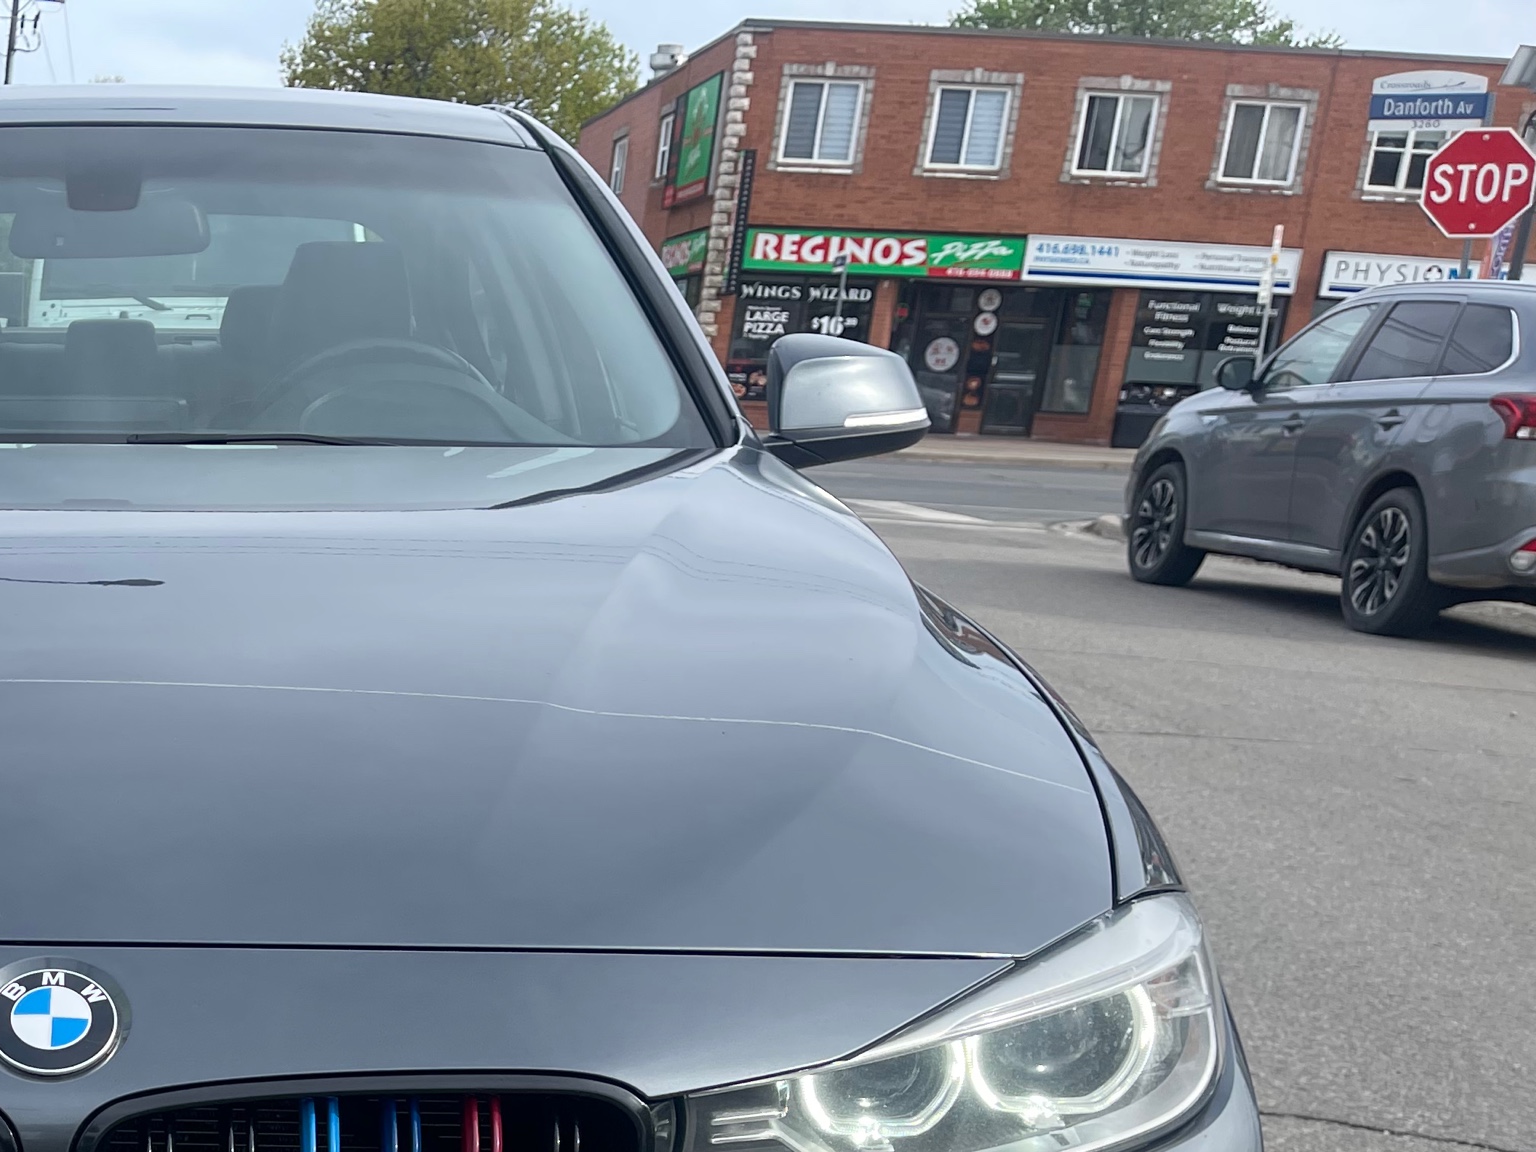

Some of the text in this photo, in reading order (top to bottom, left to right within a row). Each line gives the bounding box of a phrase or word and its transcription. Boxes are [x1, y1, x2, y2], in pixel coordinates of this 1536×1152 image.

[1383, 98, 1474, 115] Danforth Av
[1429, 163, 1528, 203] STOP
[752, 232, 1014, 266] REGINOS Pizza
[740, 282, 872, 302] WINGS WIZARD
[745, 310, 790, 323] LARGE
[744, 321, 785, 334] PIZZA
[1, 971, 108, 1004] BMW
